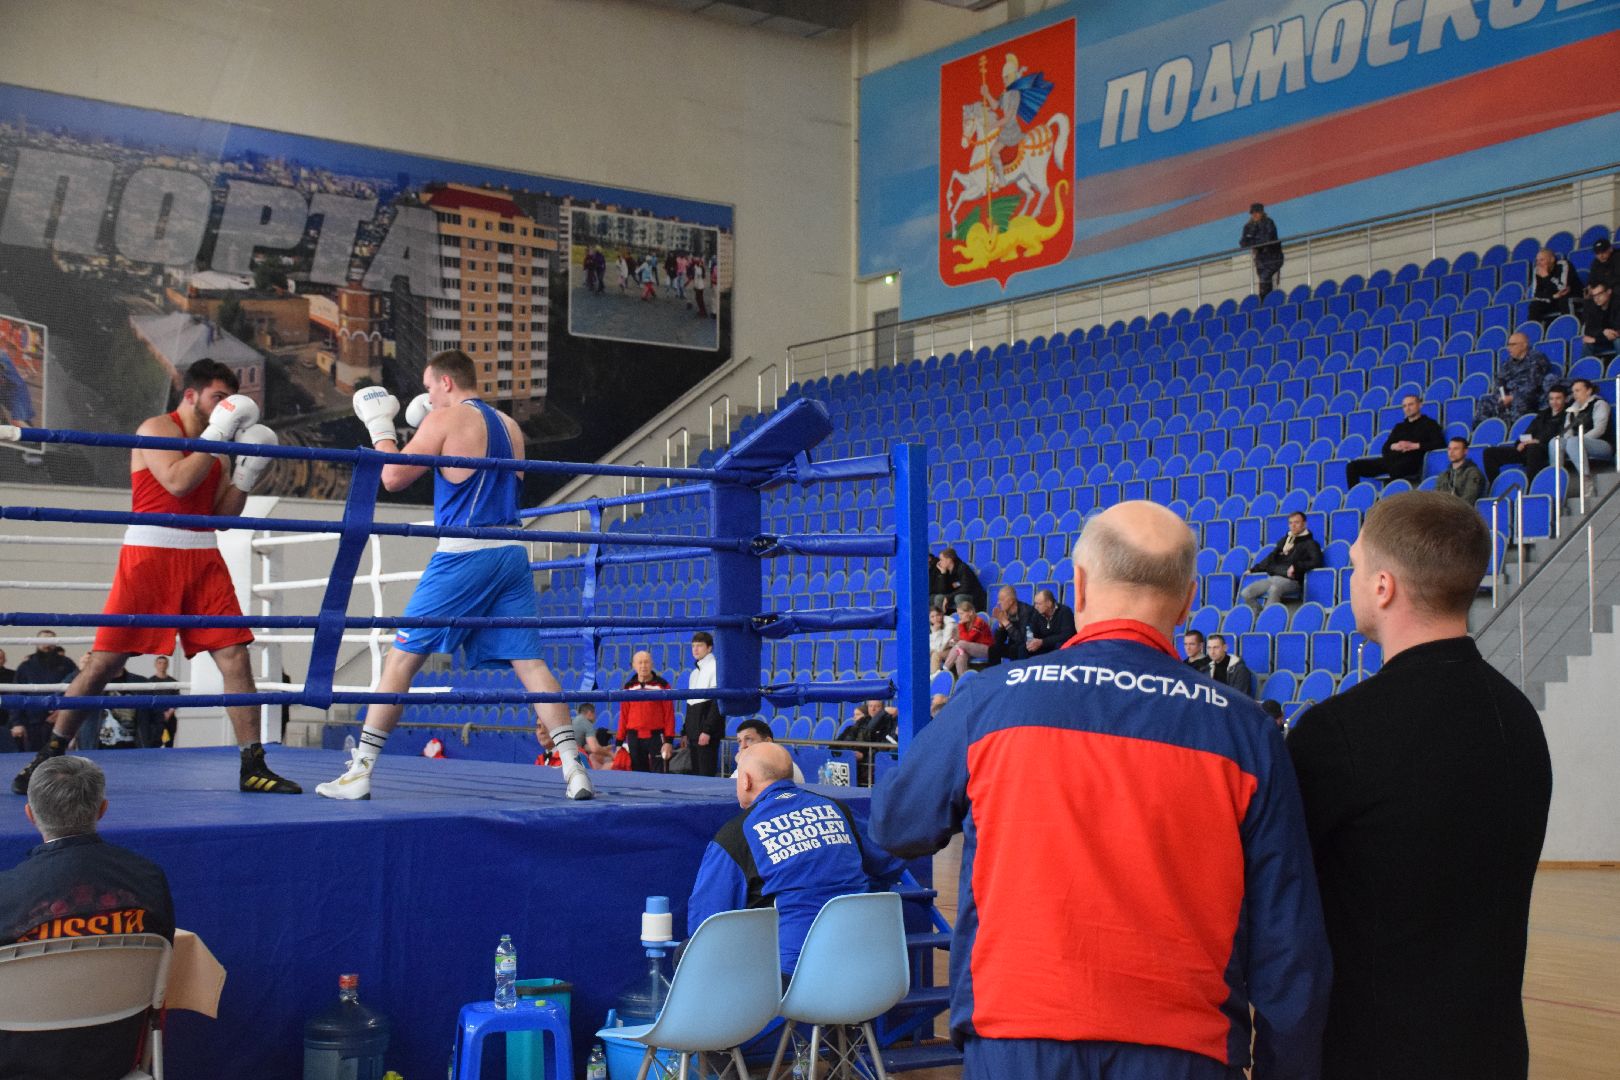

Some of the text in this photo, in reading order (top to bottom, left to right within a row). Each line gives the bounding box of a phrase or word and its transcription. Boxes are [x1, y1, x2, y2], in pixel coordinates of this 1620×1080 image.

[1098, 0, 1597, 149] ПОДМОСК
[1005, 664, 1229, 708] ЭЛЕКТРОСТАЛЬ
[752, 804, 841, 840] RUSSIA
[762, 820, 845, 855] KOROLEV
[769, 833, 852, 865] BOXING TEAM
